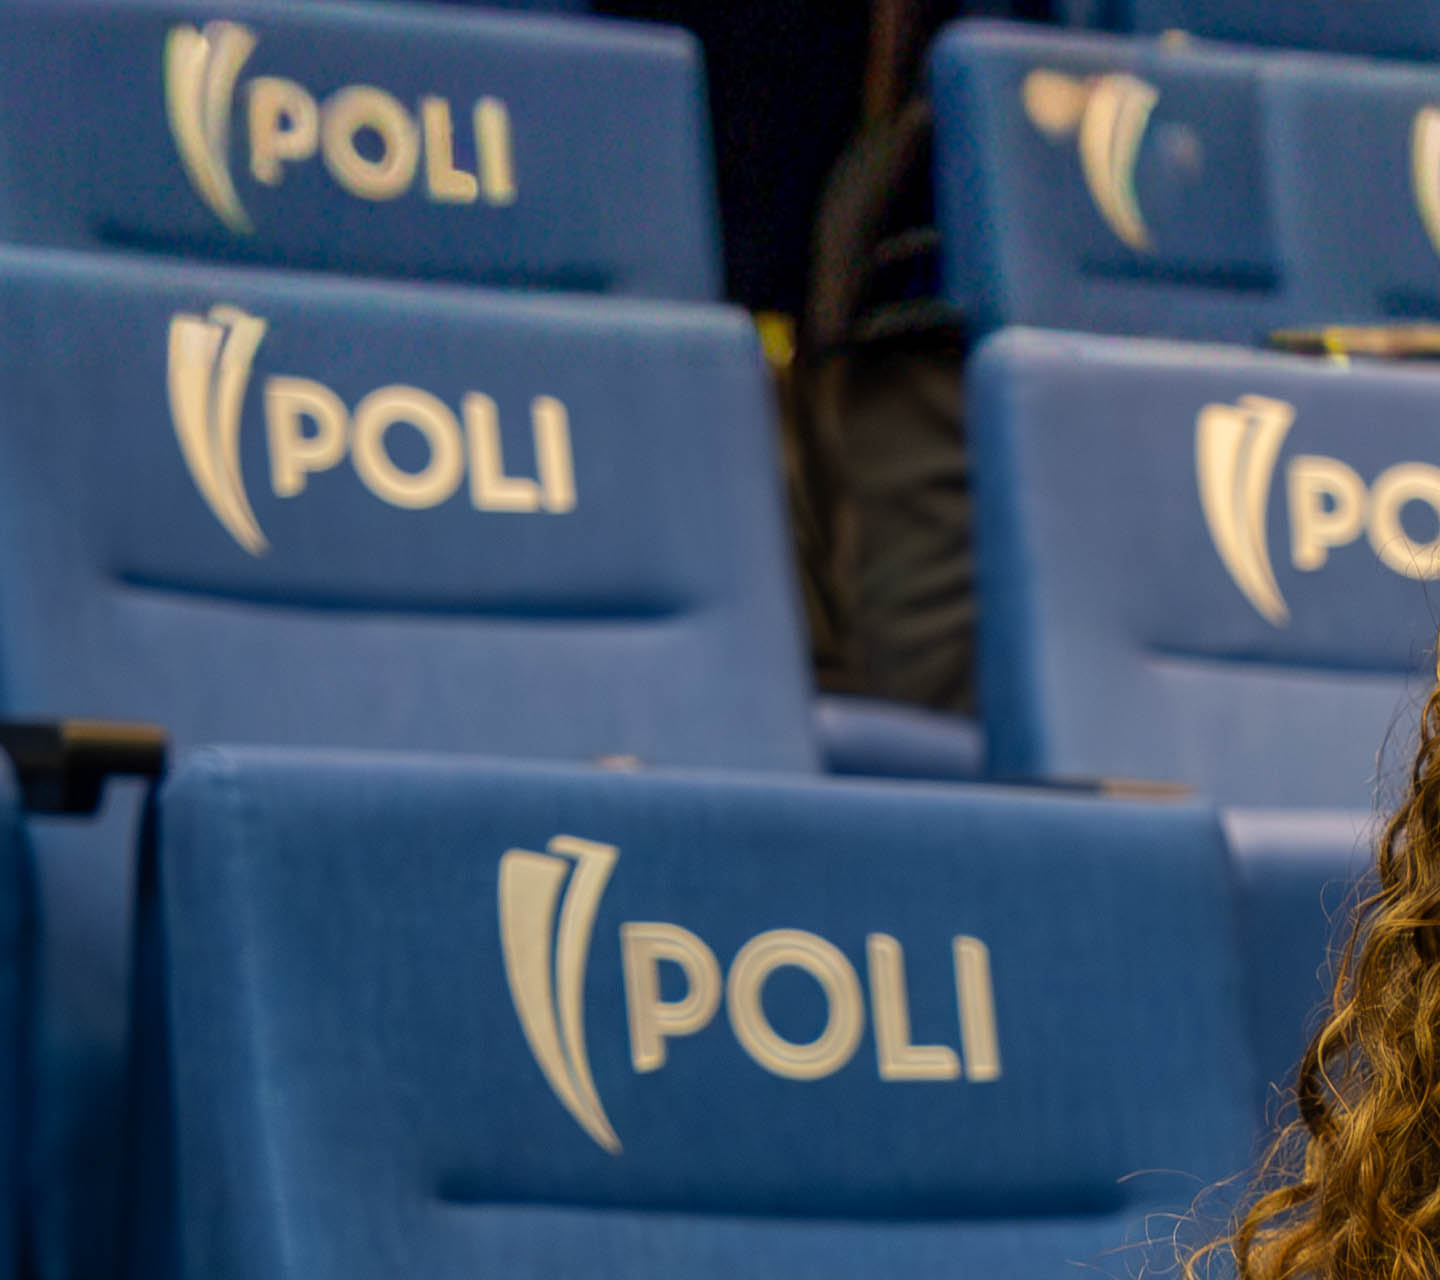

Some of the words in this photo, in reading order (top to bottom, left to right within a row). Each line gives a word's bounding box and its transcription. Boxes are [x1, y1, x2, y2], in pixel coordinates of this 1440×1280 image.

[245, 76, 515, 204] POLI
[264, 376, 577, 515] POLI
[620, 920, 1001, 1084] POLI
